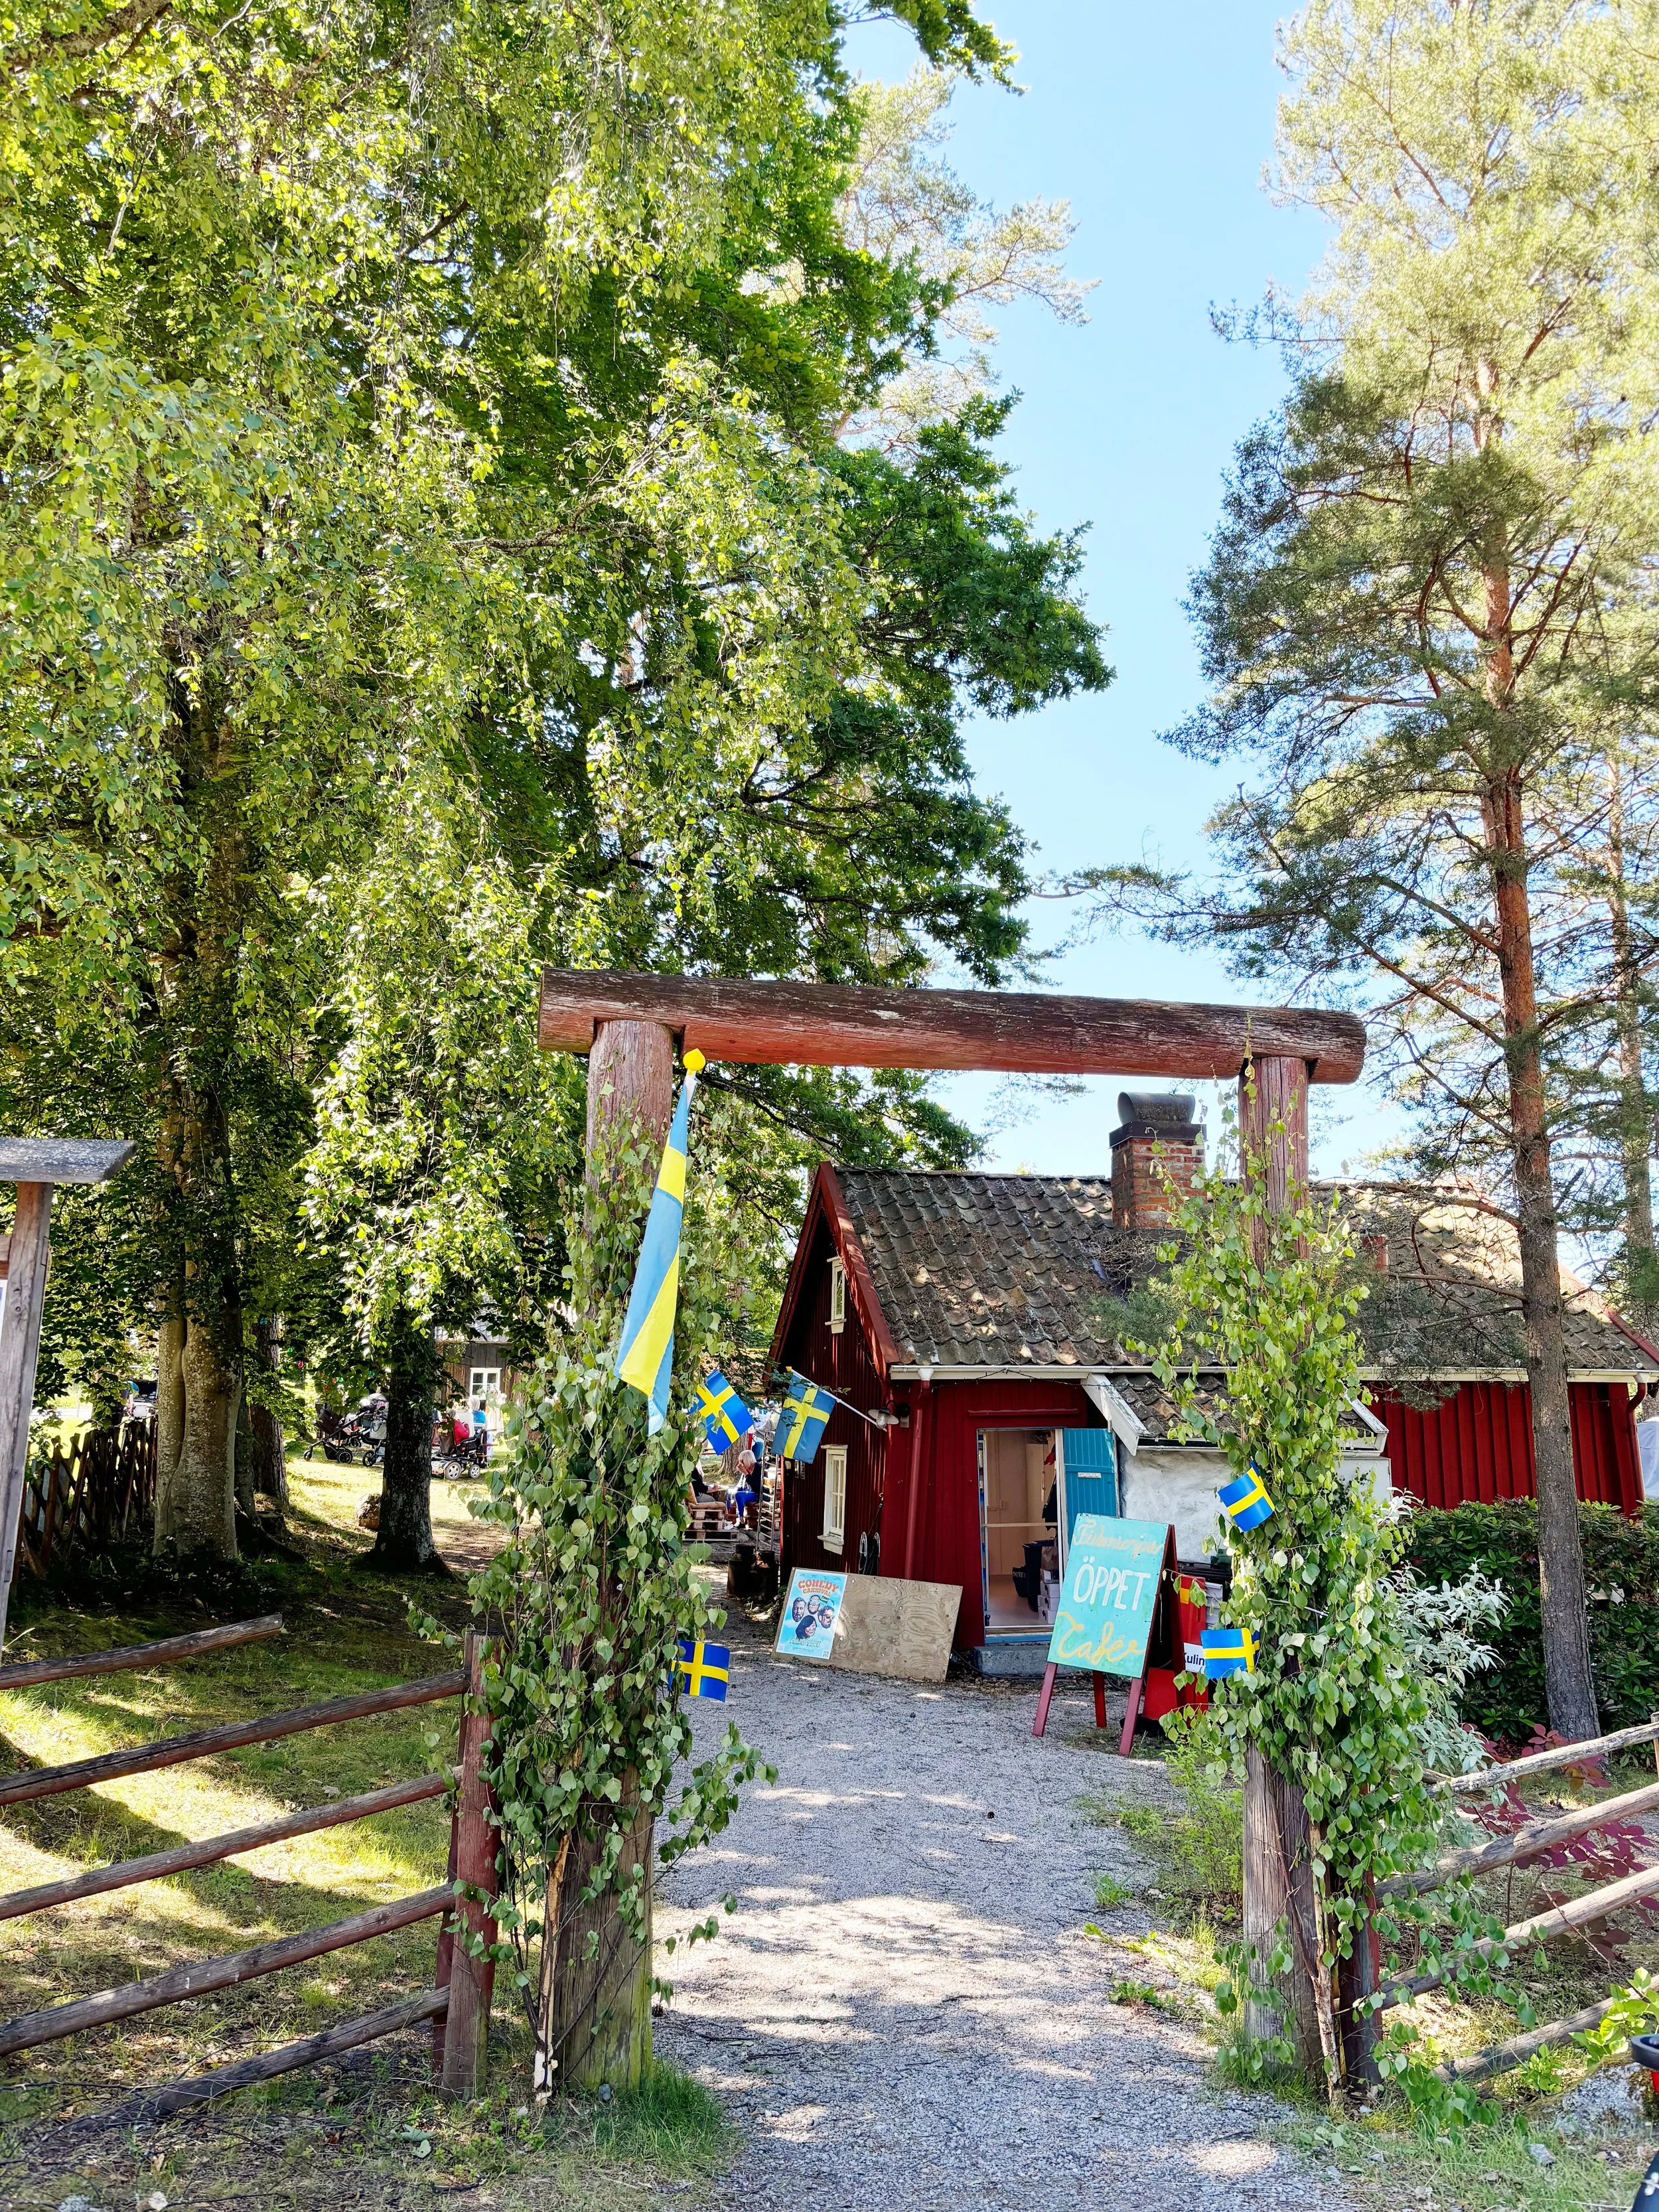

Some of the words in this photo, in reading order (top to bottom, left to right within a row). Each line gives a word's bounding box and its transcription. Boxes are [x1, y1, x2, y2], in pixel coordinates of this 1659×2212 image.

[798, 1579, 839, 1593] COMEDY
[1073, 1556, 1151, 1611] ÖPPET
[802, 1587, 831, 1597] CARNIVAL
